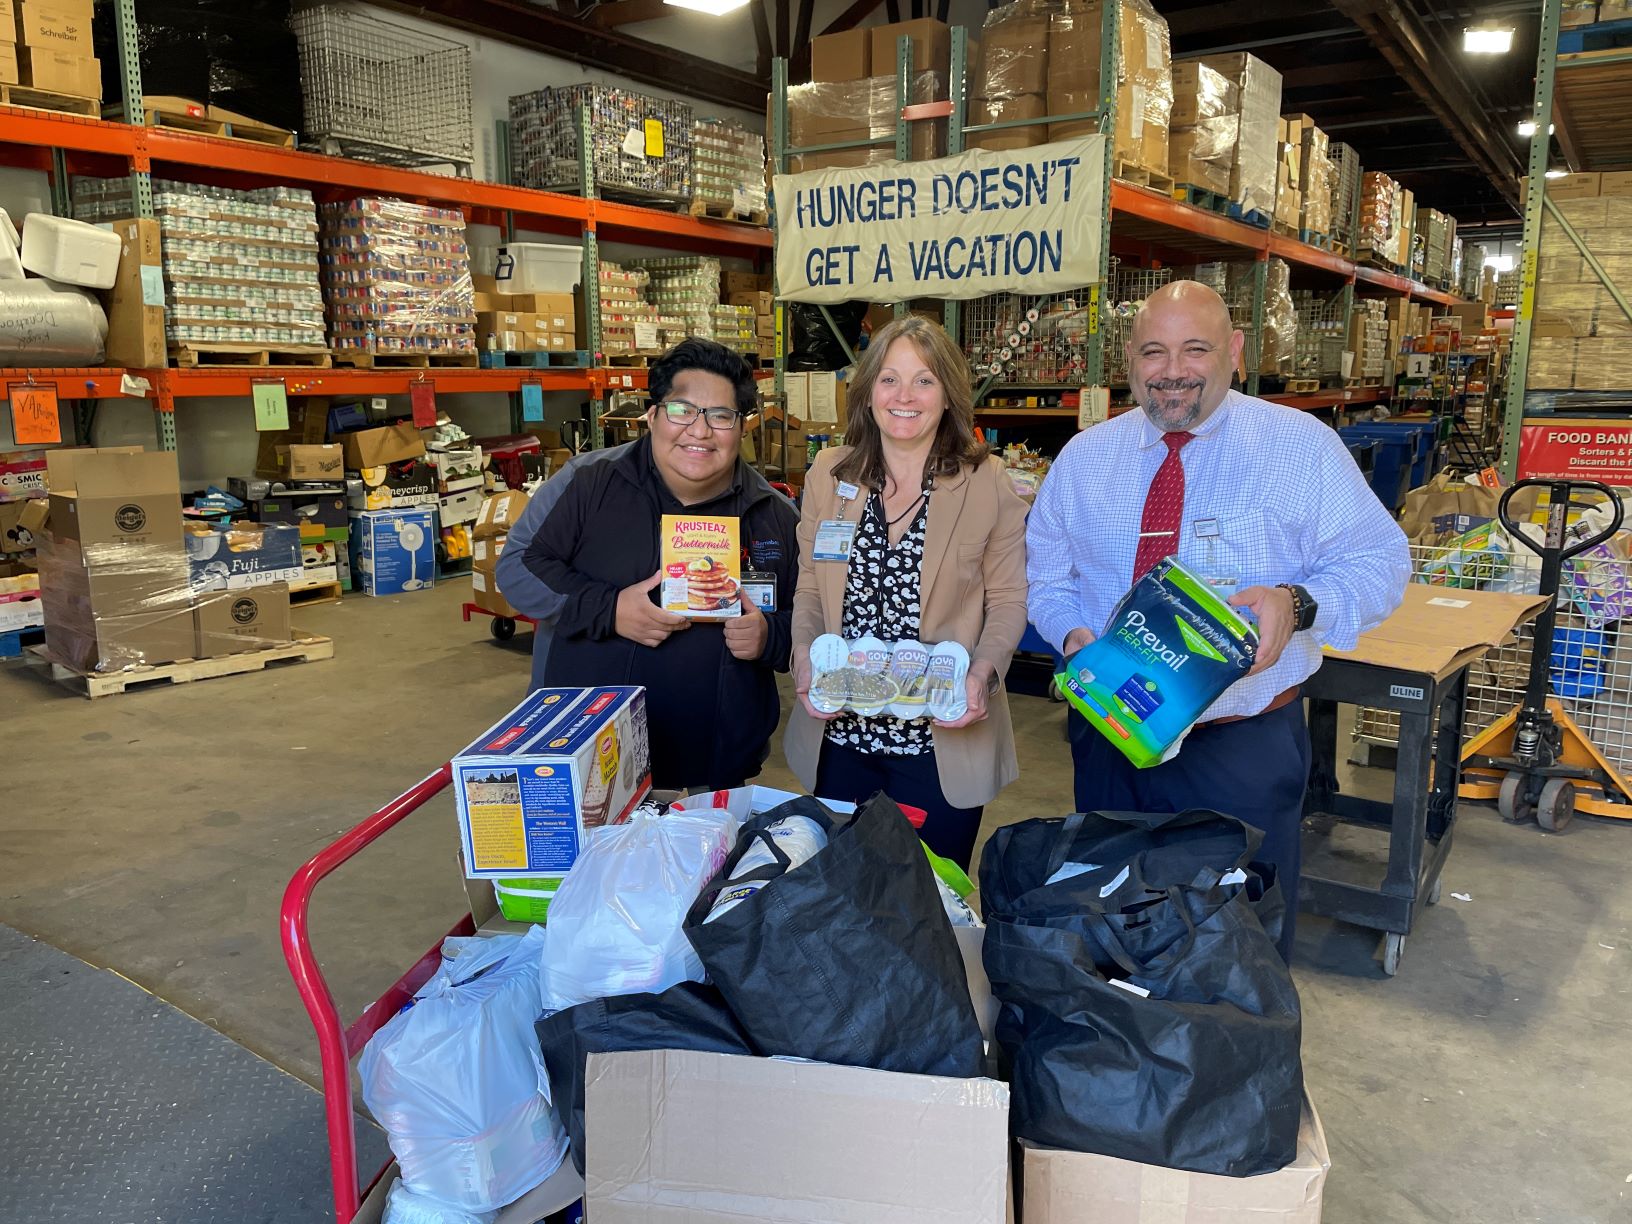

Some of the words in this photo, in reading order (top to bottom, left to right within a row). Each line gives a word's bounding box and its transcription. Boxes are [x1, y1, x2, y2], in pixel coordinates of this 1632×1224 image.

[40, 26, 77, 41] Schreiber
[797, 177, 917, 229] HUNGER
[932, 157, 1080, 217] DOESN'T
[805, 245, 861, 288] GET
[873, 243, 894, 283] A
[908, 228, 1063, 282] VACATION
[1414, 361, 1424, 374] 1
[1548, 432, 1592, 444] FOOD
[1579, 447, 1615, 456] Sorters
[1618, 448, 1625, 456] &
[1569, 457, 1607, 466] Discard
[1610, 458, 1625, 466] the
[400, 494, 436, 506] APPLES
[675, 521, 727, 534] KRUSTEAZ
[672, 535, 731, 550] Buttermilk
[231, 557, 260, 573] Fuji
[244, 568, 299, 585] APPLES
[1116, 627, 1161, 664] PER-FIT
[1124, 610, 1190, 673] Prevail
[897, 651, 927, 662] GOYA
[1067, 679, 1079, 691] 18
[1392, 686, 1422, 698] ULINE
